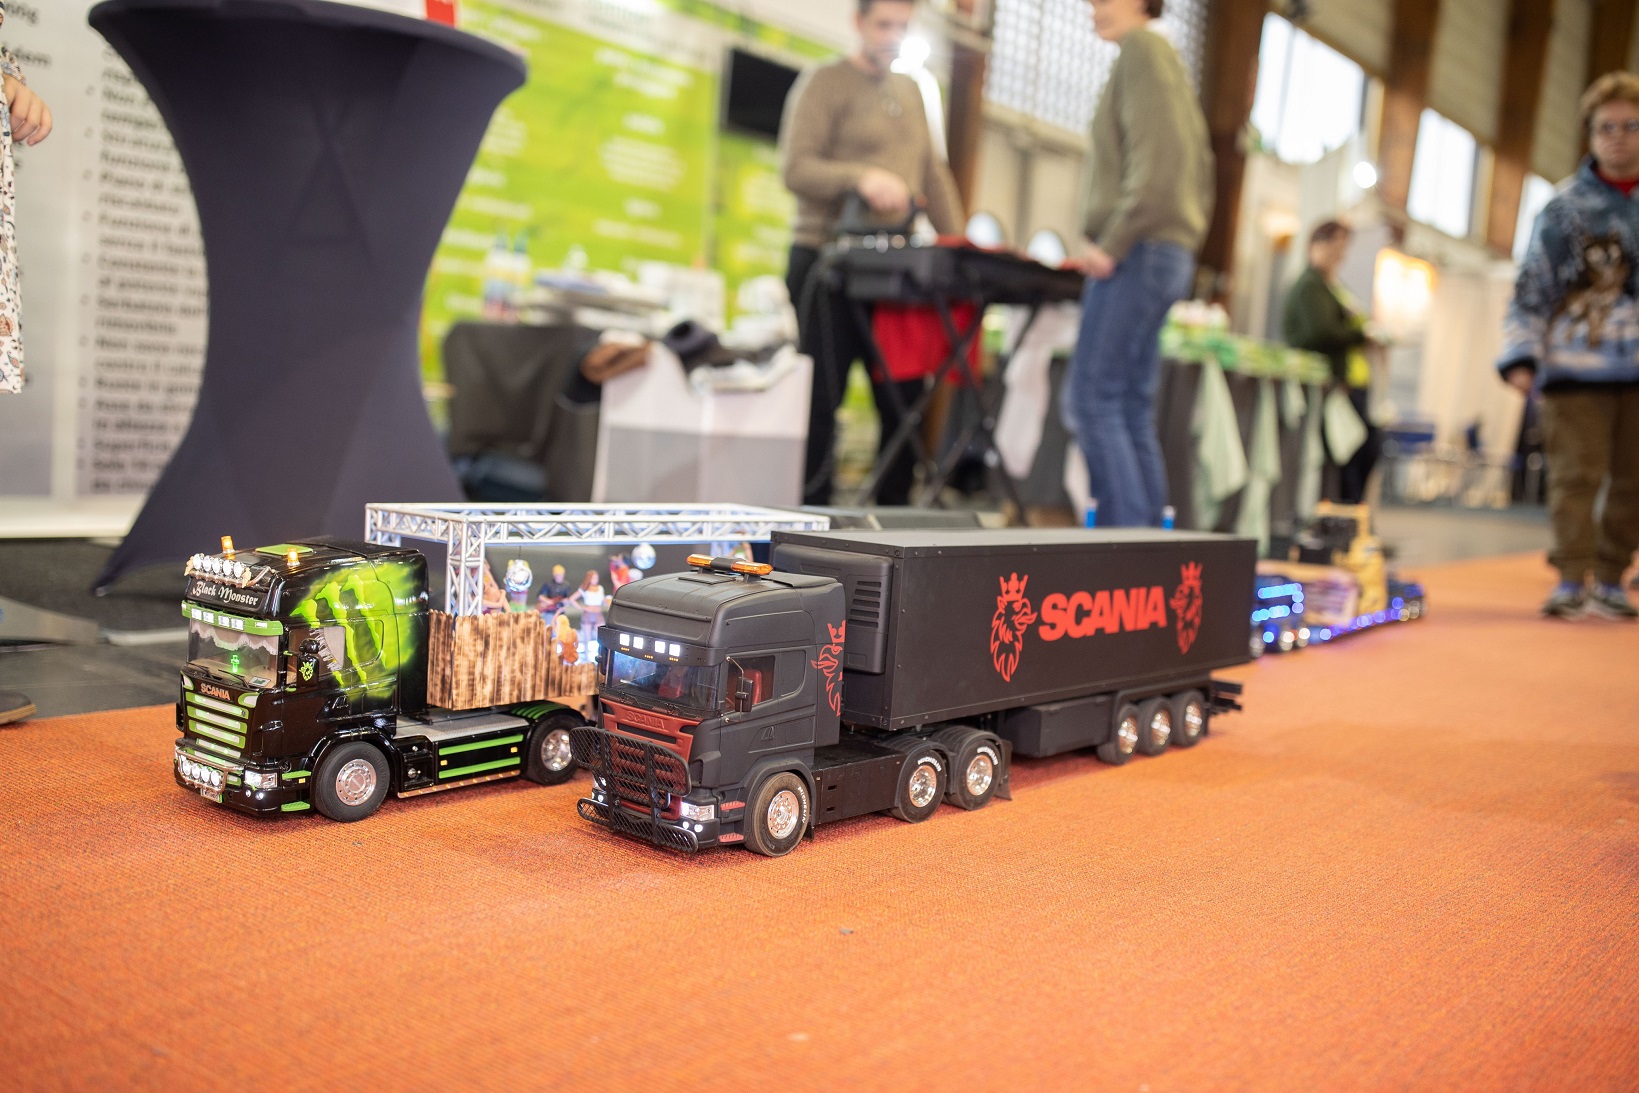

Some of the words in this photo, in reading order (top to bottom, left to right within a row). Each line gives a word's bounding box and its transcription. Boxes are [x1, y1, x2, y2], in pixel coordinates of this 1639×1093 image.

[191, 580, 216, 597] Black
[218, 586, 259, 606] Monster
[1038, 585, 1168, 642] SCANIA
[200, 682, 231, 701] SCANIA
[626, 710, 665, 730] SCANIA
[797, 785, 808, 824] MICHELIN
